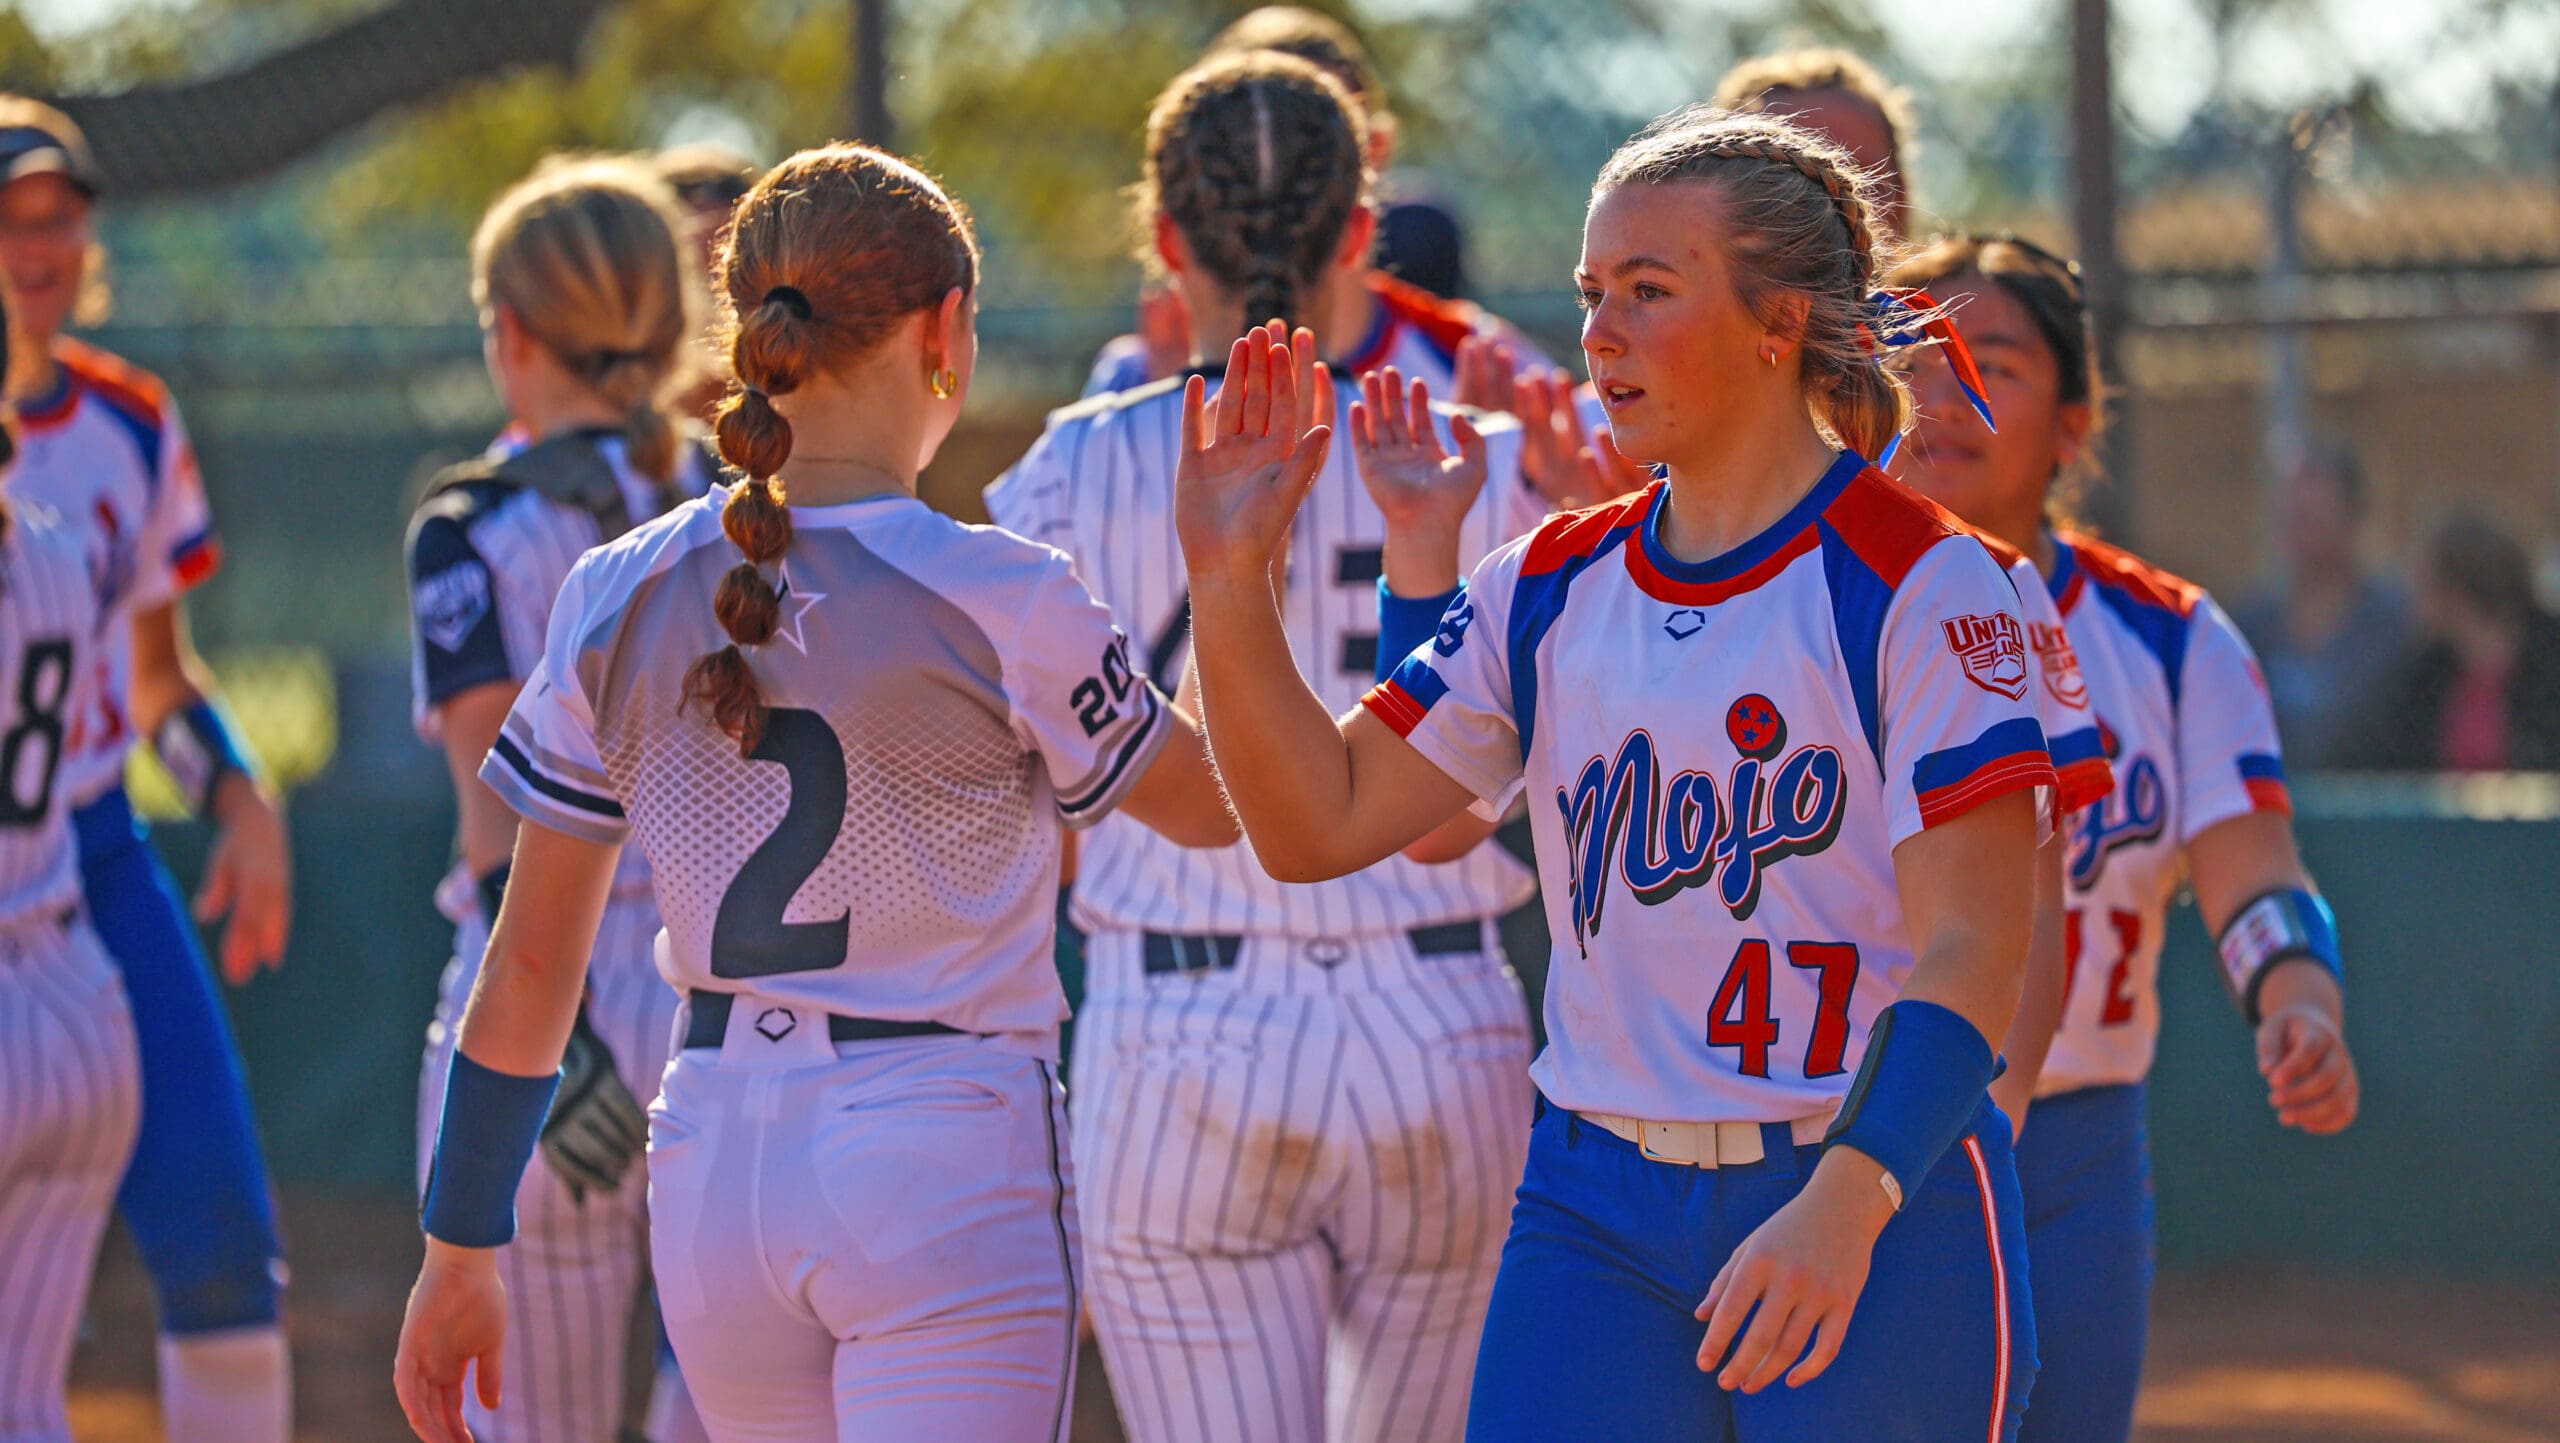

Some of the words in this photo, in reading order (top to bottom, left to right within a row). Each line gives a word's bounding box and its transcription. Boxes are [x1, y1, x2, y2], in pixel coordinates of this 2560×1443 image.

[711, 706, 850, 979] 2
[1556, 693, 1848, 960] Mojo
[1706, 938, 1860, 1080] 47
